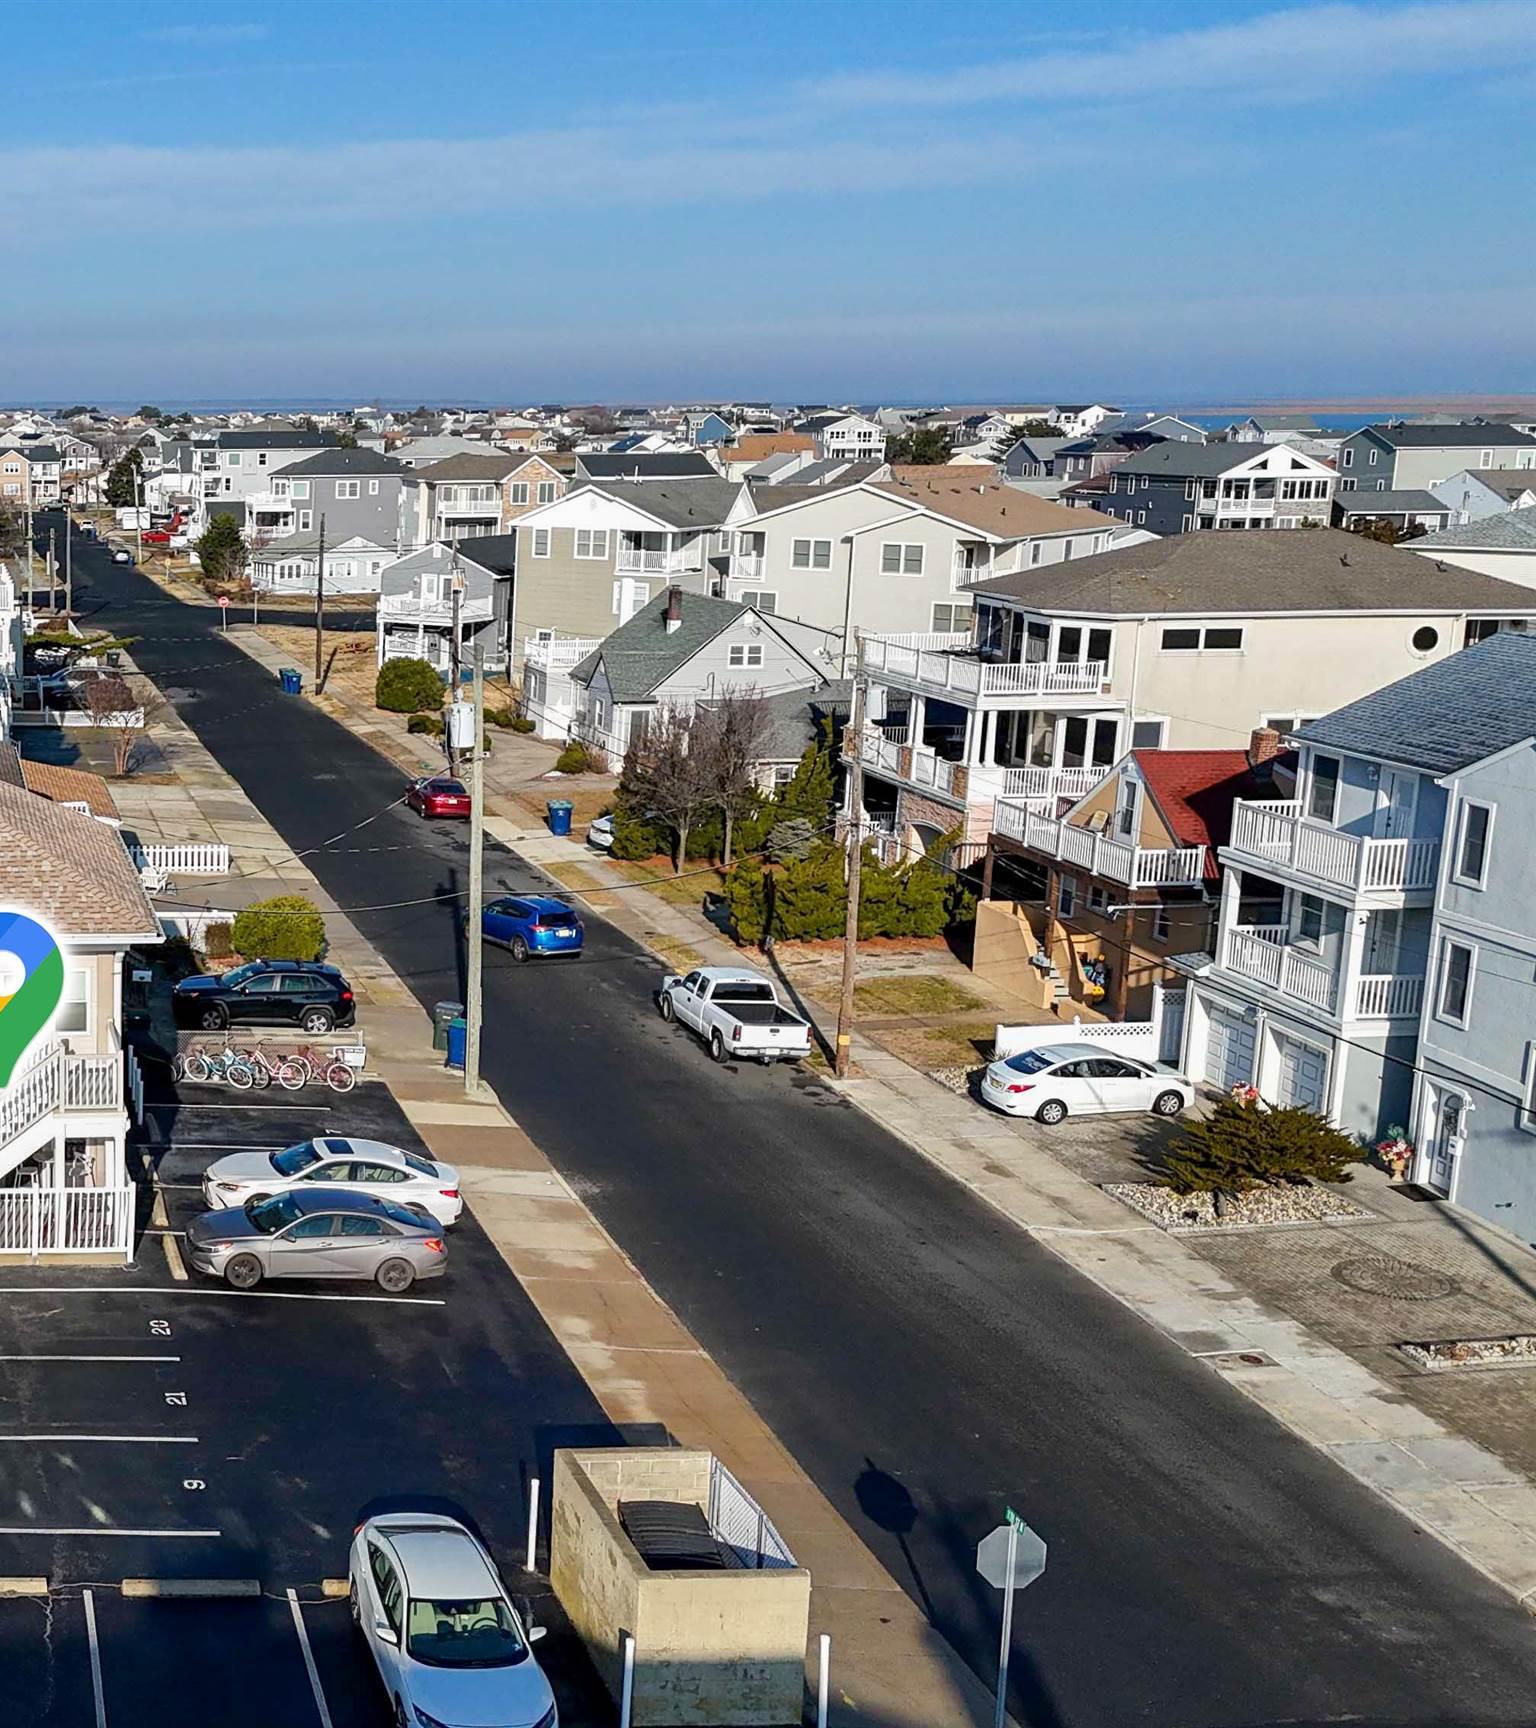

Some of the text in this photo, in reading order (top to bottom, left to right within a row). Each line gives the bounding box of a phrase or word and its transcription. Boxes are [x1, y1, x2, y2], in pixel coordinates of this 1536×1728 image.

[149, 1319, 172, 1336] 20
[164, 1391, 188, 1406] 21
[183, 1479, 207, 1490] 9
